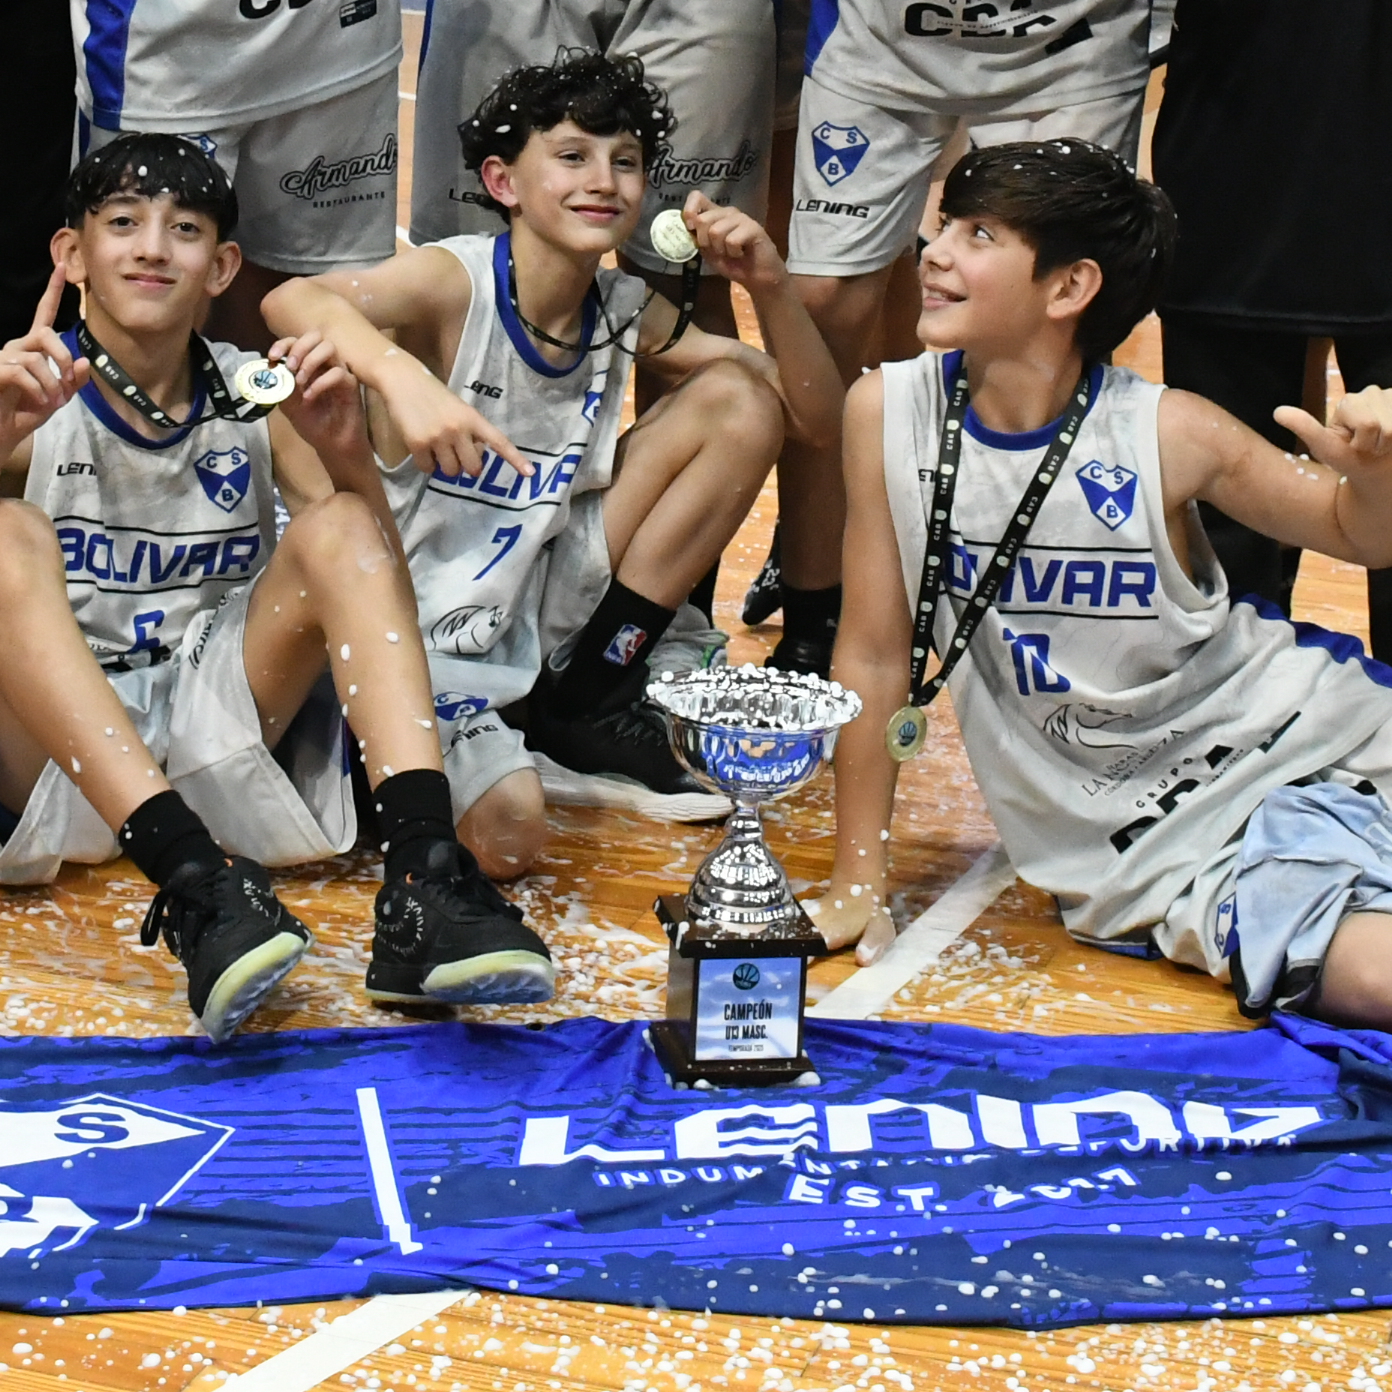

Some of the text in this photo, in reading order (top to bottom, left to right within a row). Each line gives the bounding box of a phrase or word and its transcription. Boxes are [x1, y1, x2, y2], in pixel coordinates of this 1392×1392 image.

[820, 127, 858, 145] C S
[280, 133, 398, 201] Armand
[827, 162, 840, 176] B
[312, 191, 387, 209] RESTAURANTE
[206, 451, 242, 470] C S
[1089, 467, 1124, 485] C S
[222, 488, 234, 502] B
[1106, 504, 1118, 519] B
[57, 527, 261, 585] BOLIVAR
[472, 524, 523, 581] 7
[1136, 757, 1193, 809] GRUPO
[724, 999, 773, 1020] CAMPEÓN
[725, 1024, 768, 1040] U13 MASC.
[54, 1111, 131, 1146] S
